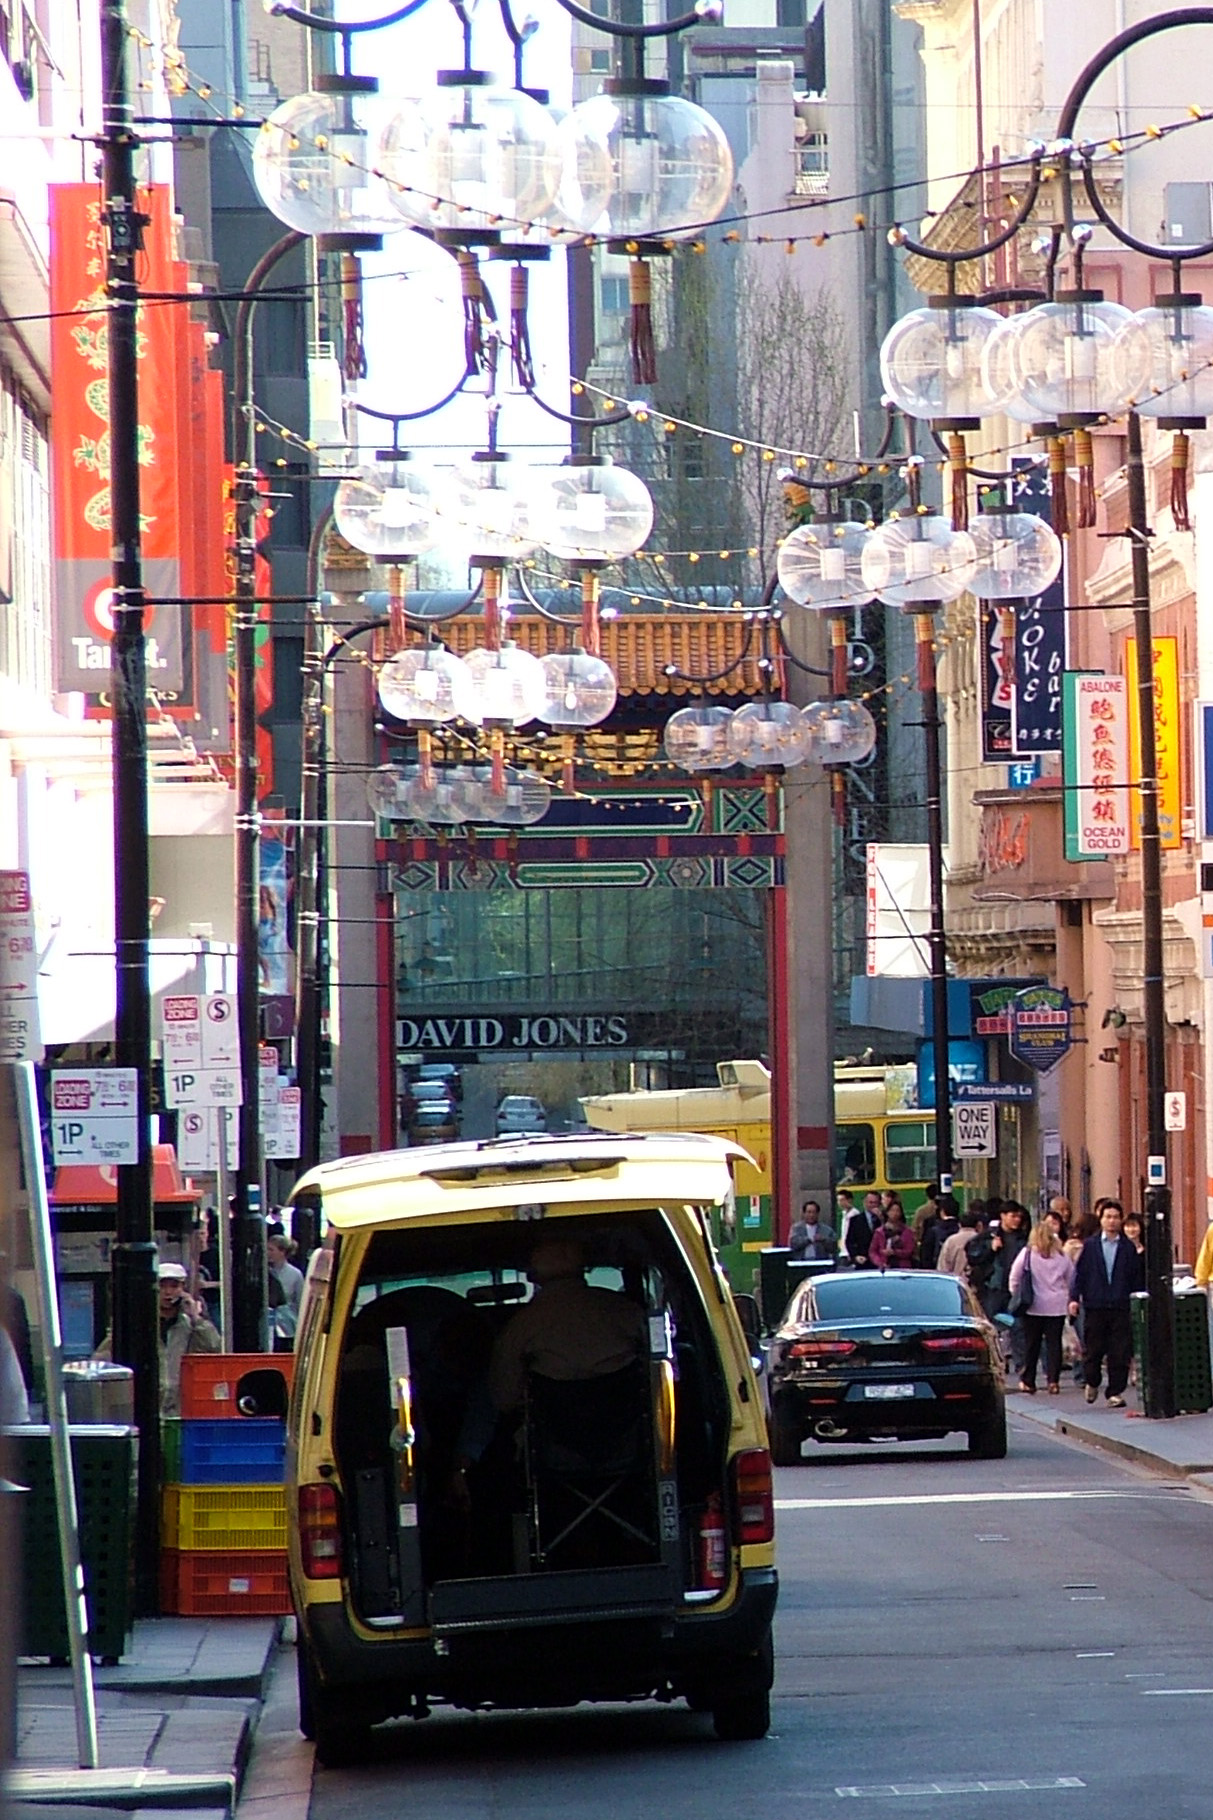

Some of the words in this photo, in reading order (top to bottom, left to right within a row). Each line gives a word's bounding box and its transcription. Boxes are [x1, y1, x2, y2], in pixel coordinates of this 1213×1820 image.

[1047, 651, 1061, 713] bar
[1080, 681, 1123, 693] ABALONE
[1083, 827, 1126, 838] OCEAN
[1087, 838, 1121, 850] GOLD
[395, 1018, 504, 1047] DAVID
[512, 1016, 628, 1046] JONES
[57, 1082, 90, 1094] LOADING
[172, 1074, 195, 1093] 1P
[56, 1095, 90, 1108] ZONE
[958, 1107, 989, 1124] ONE
[58, 1122, 84, 1146] 1P
[958, 1125, 990, 1140] WAY
